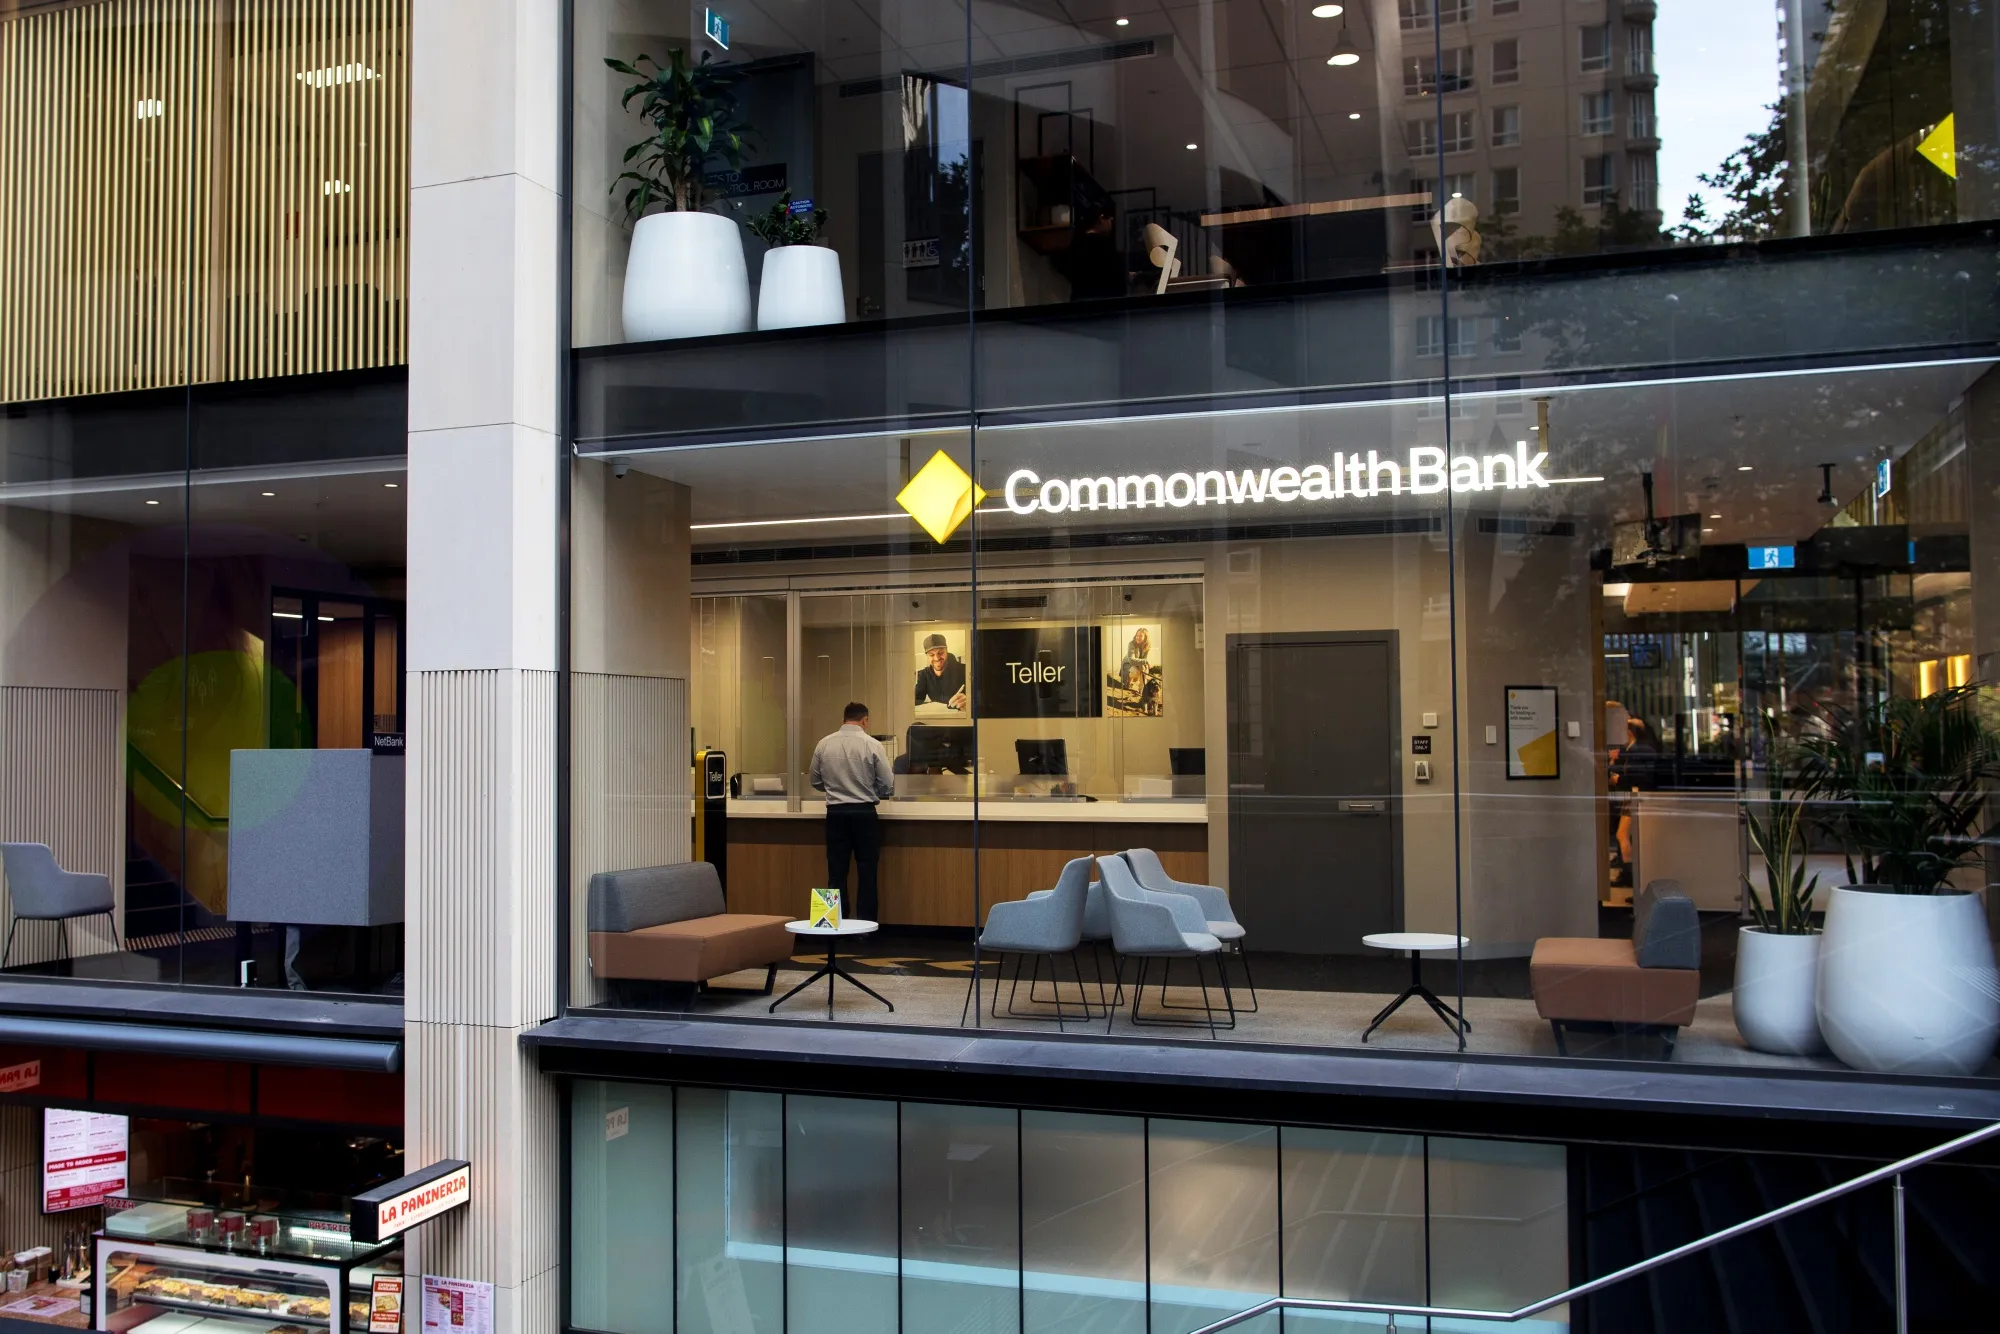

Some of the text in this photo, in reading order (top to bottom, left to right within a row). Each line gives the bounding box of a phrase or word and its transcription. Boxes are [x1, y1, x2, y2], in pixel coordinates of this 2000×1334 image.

[753, 178, 785, 191] ROOM
[1005, 441, 1550, 514] CommonwealthBank
[1006, 662, 1066, 683] Teller
[374, 735, 404, 747] NetBank
[709, 771, 723, 783] Teller
[104, 1197, 135, 1210] PIZZA
[381, 1206, 397, 1225] LA
[401, 1175, 466, 1216] PANINERIA
[309, 1220, 351, 1233] PASTRIE
